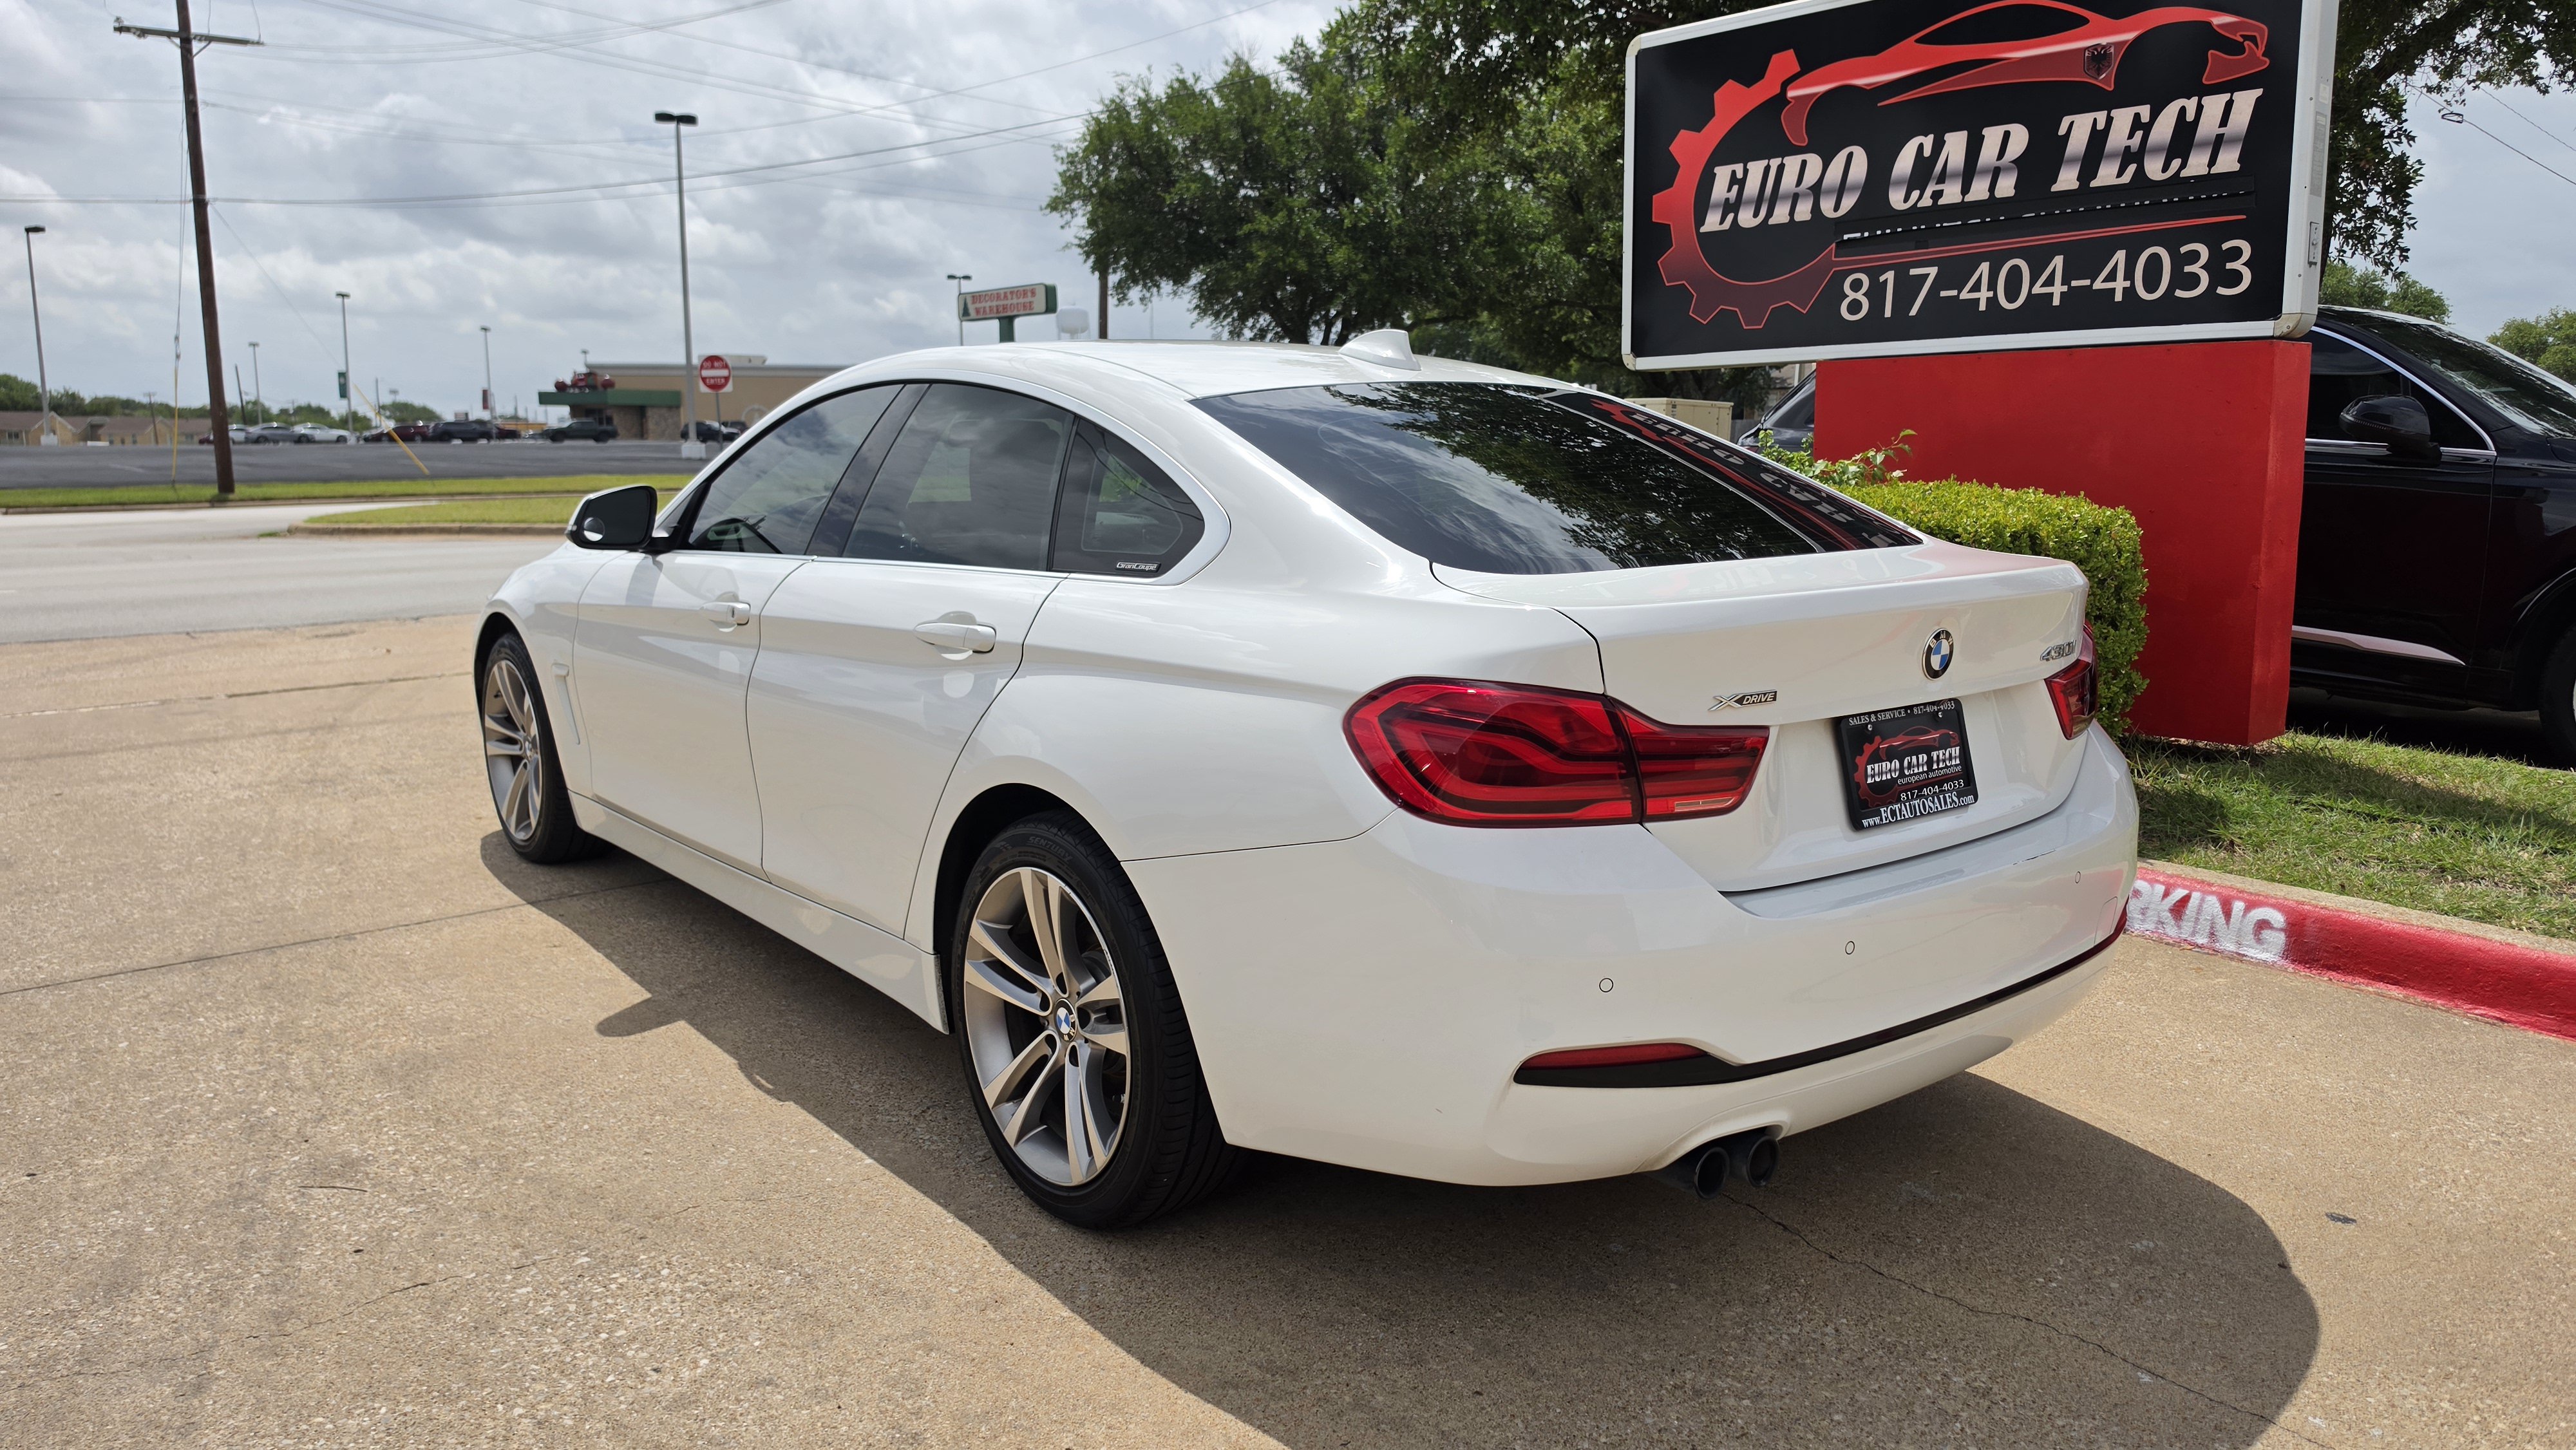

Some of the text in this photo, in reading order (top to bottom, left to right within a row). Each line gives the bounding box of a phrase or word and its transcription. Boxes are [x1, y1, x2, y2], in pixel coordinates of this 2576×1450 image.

[1699, 145, 1868, 233] EURO
[1888, 122, 2030, 211] CAR
[2050, 88, 2264, 193] TECH
[1839, 239, 2253, 322] 817-404-4033
[971, 288, 1036, 305] DECORATOR'S
[975, 301, 1034, 316] WAREHOUSE
[703, 360, 712, 368] DO
[1848, 715, 1869, 726] SALES
[1877, 709, 1906, 720] SERVICE
[1866, 746, 1960, 784] EURO CAR TECH
[1897, 765, 1962, 786] european automotive
[1900, 779, 1964, 801] 817-404-4033
[1862, 791, 1975, 828] www.ECTAUTOSALES.com
